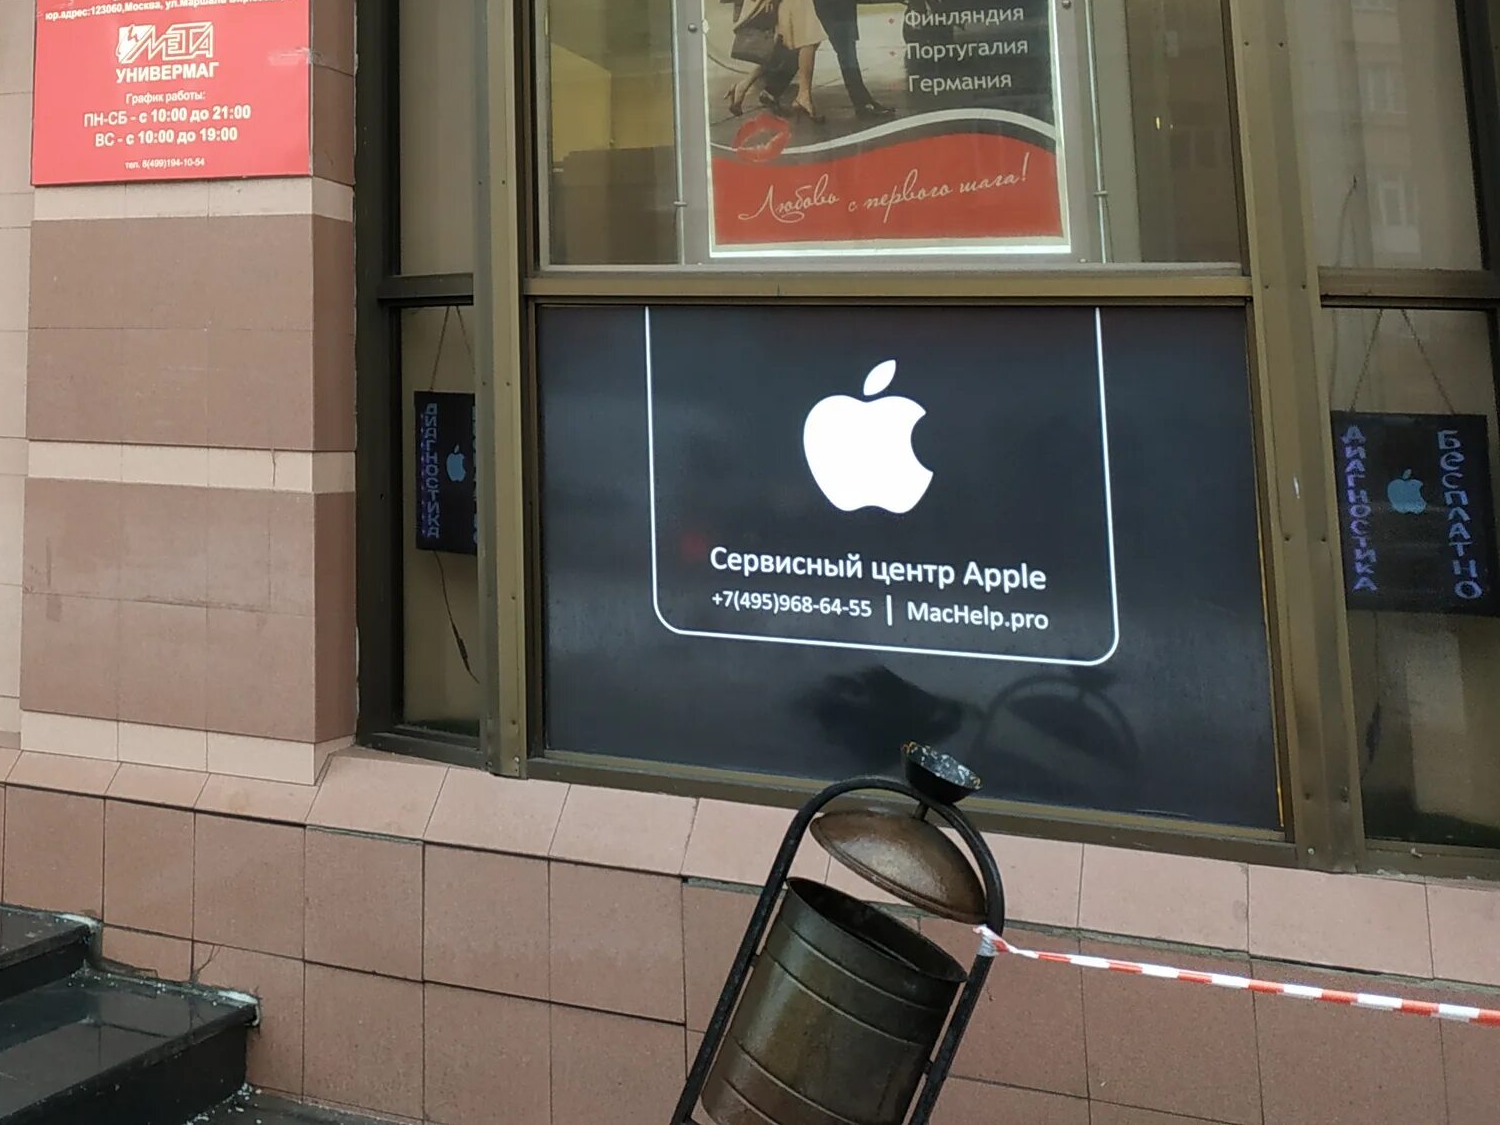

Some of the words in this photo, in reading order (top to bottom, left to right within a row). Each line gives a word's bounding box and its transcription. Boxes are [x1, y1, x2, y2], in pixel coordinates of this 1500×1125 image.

[904, 7, 1024, 28] Финляндия
[906, 40, 1029, 61] Португалия
[116, 62, 219, 83] УНИВЕРМАГ
[908, 74, 1012, 92] Германия
[126, 93, 164, 105] График
[165, 90, 206, 103] работы:
[84, 111, 127, 127] ПН-СБ
[151, 107, 188, 122] 10:00
[190, 109, 210, 123] до
[212, 104, 251, 120] 21:00
[95, 133, 115, 147] ВС
[138, 129, 174, 144] 10:00
[177, 132, 196, 144] до
[200, 126, 238, 141] 19:00
[738, 174, 839, 222] Любовь
[864, 169, 952, 223] первого
[959, 152, 1030, 193] шага!
[710, 546, 863, 578] Сервисный
[871, 562, 955, 590] центр
[963, 561, 1047, 593] Apple
[711, 590, 872, 618] +7(495)968-64-55
[907, 601, 1049, 632] MacHelp.pro
